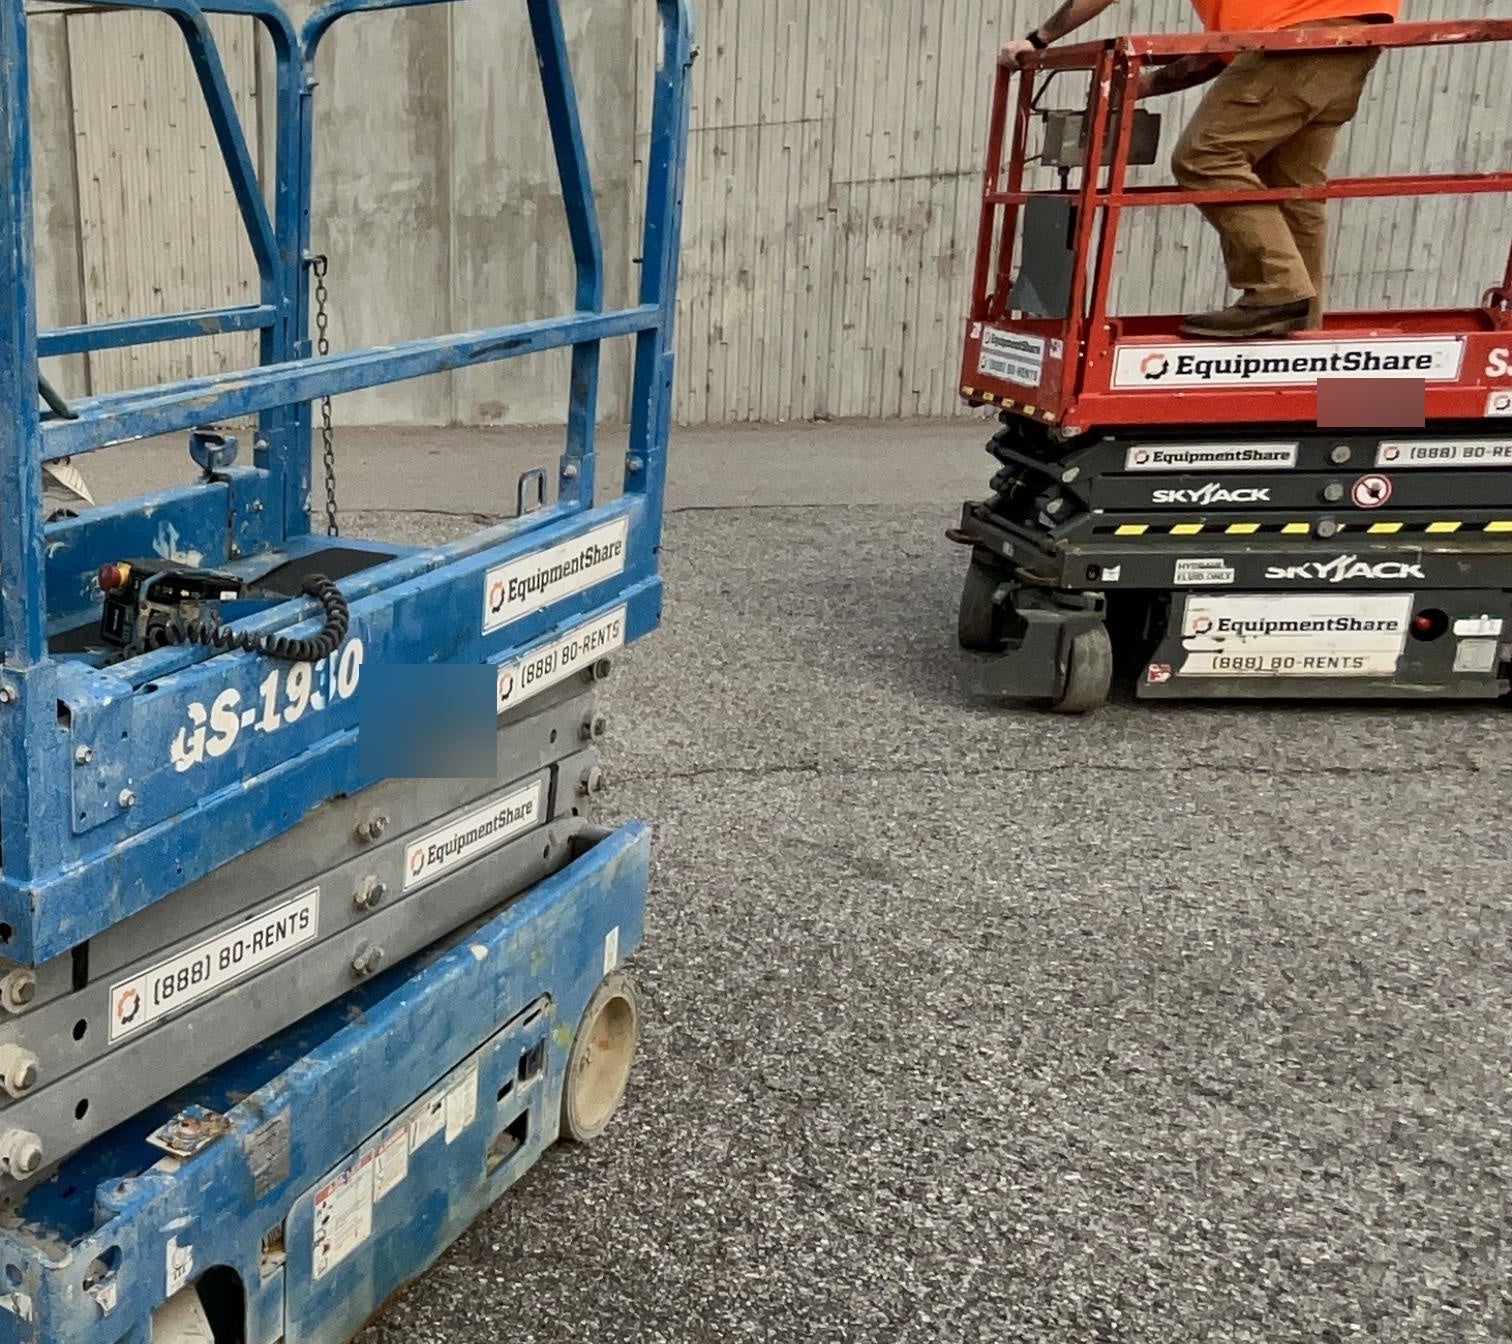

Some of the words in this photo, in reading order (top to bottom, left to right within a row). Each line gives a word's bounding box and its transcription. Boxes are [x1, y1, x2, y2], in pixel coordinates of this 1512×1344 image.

[1174, 350, 1433, 380] EquipmentShare
[1152, 449, 1291, 465] EquipmentShare
[1410, 446, 1457, 460] (888)
[1151, 482, 1271, 506] SKYJACK
[507, 539, 623, 603] EquipmentShare
[1264, 554, 1426, 583] SKYJACK
[1217, 616, 1399, 636] EquipmentShare
[520, 649, 558, 689] (888)
[560, 618, 621, 666] 80-RENTS
[1212, 655, 1264, 671] (888)
[1270, 655, 1364, 670] 80-RENTS
[426, 798, 533, 865] EquipmentShare
[153, 954, 212, 1006] (888)
[217, 906, 310, 972] 80-RENTS
